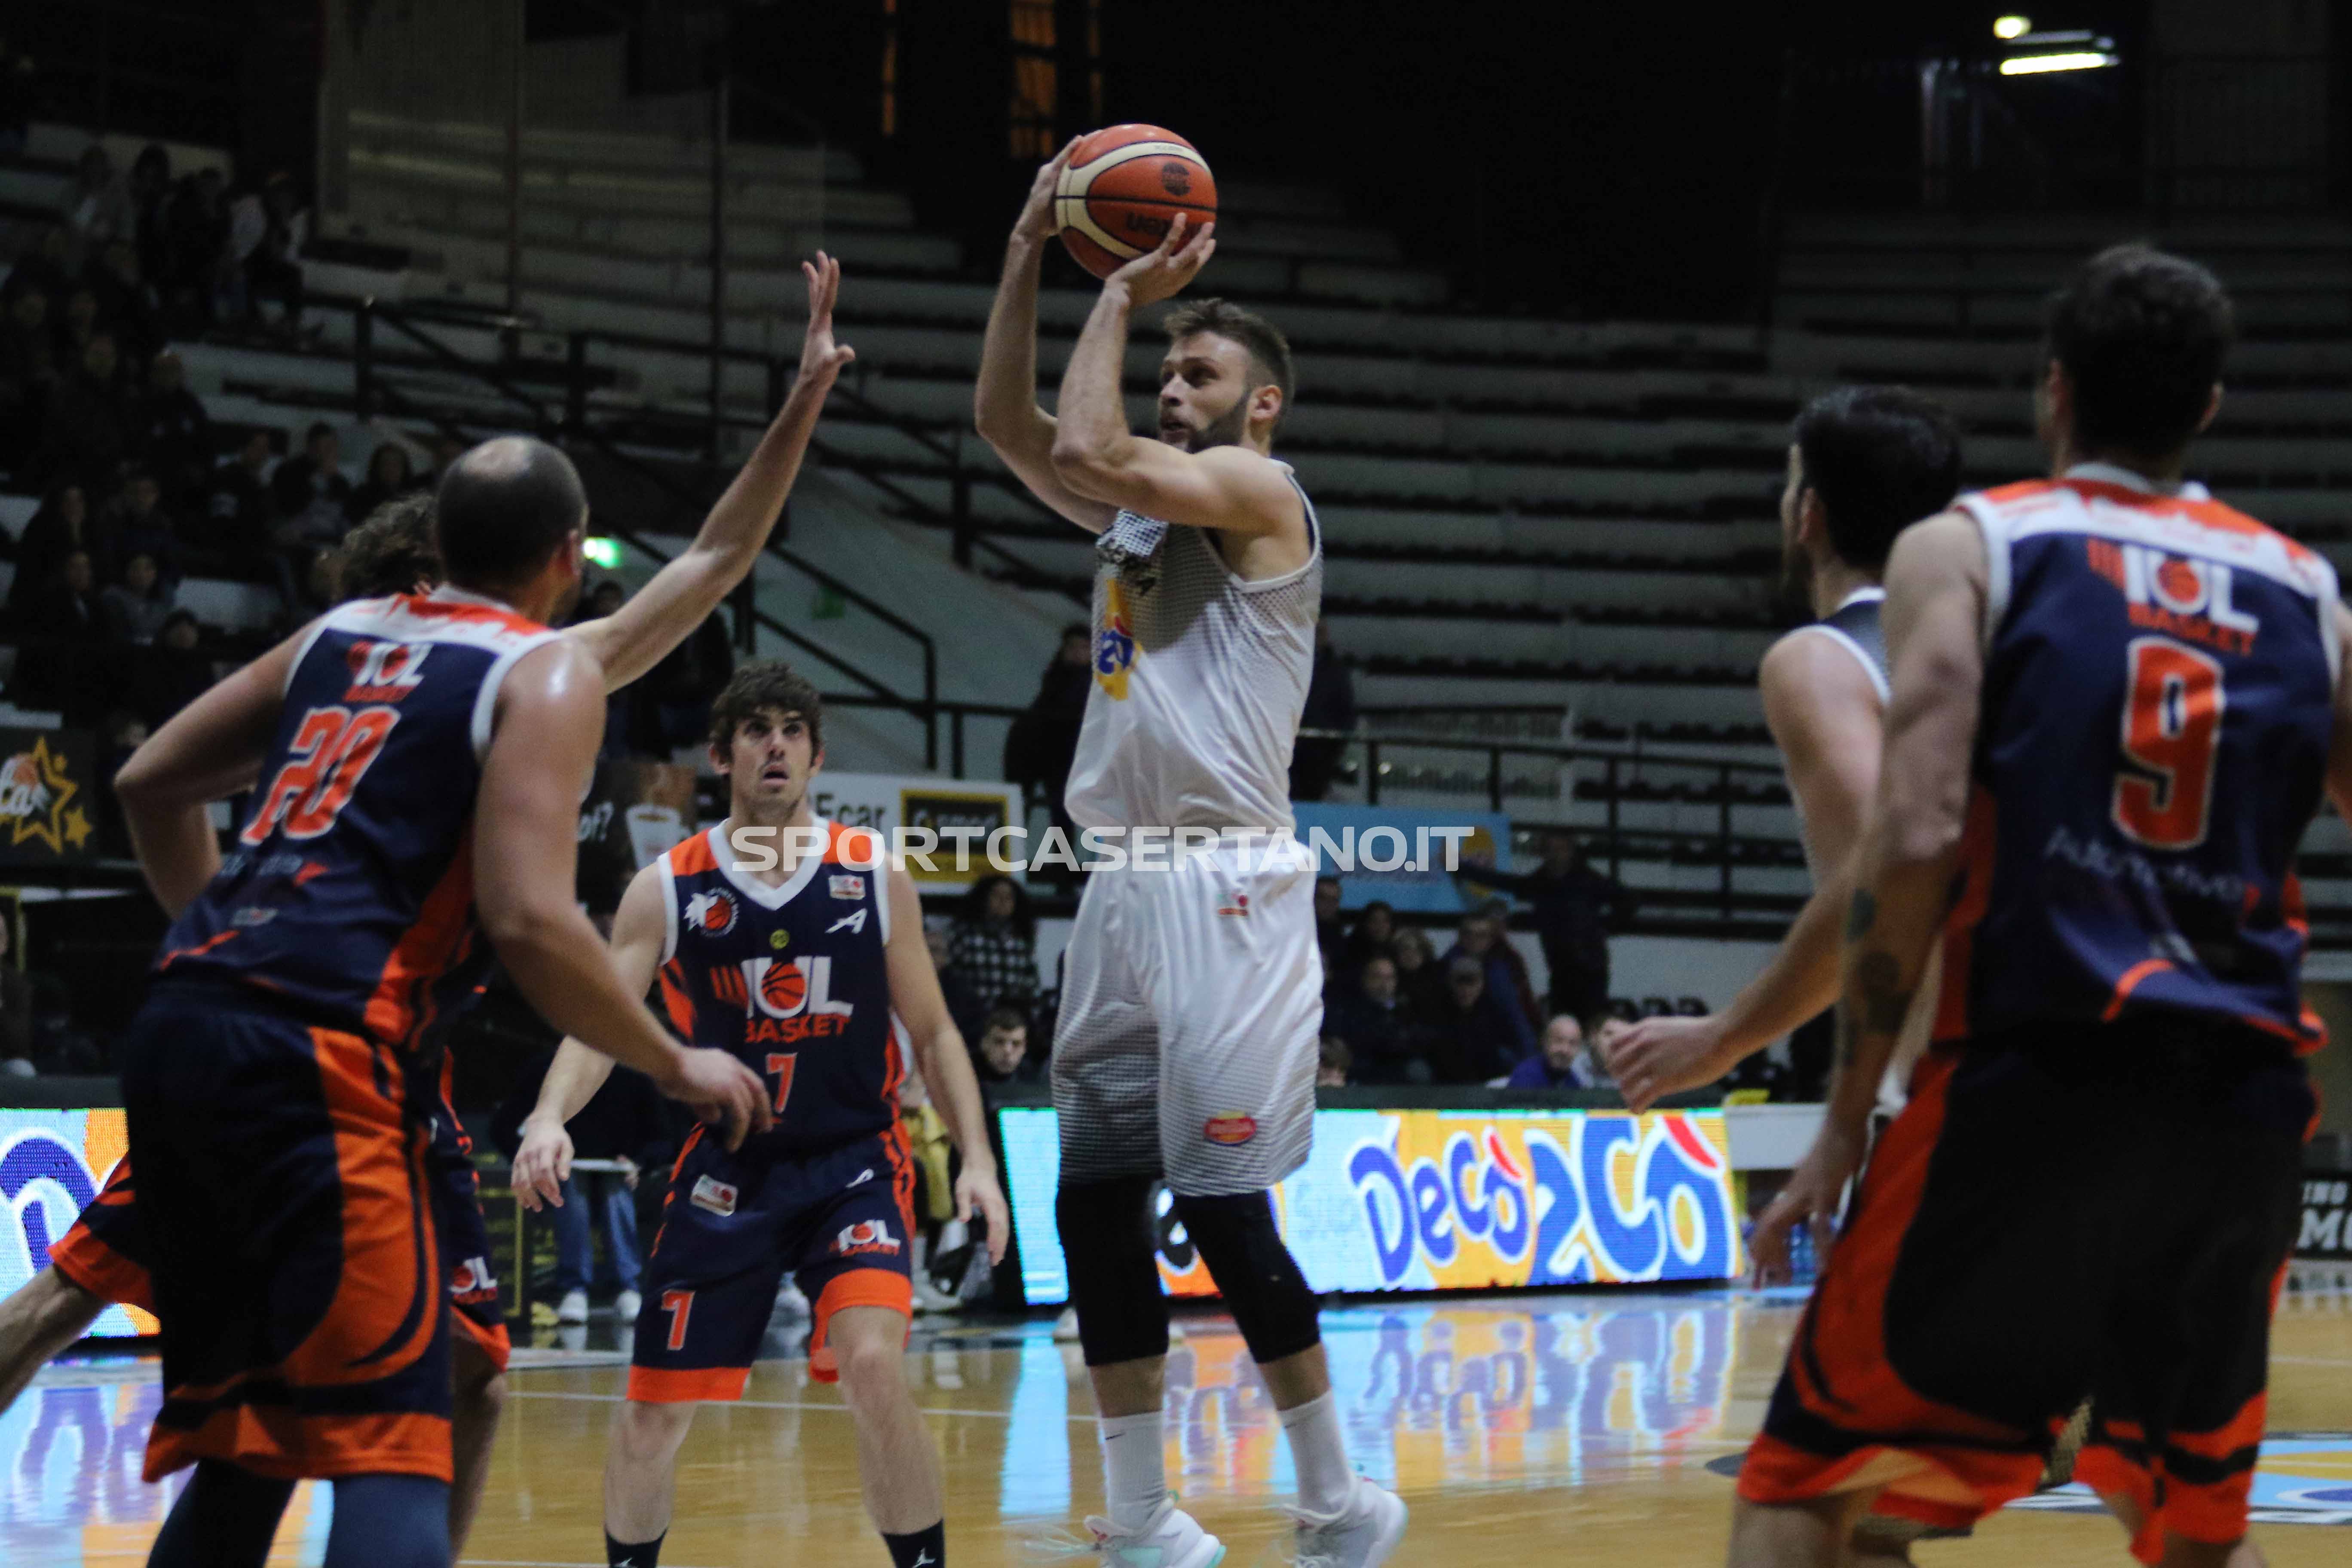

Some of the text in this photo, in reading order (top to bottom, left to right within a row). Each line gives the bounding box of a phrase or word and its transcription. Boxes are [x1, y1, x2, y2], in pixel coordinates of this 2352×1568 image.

[239, 704, 401, 846] 20
[2110, 635, 2226, 852] 9
[766, 1052, 798, 1114] 7
